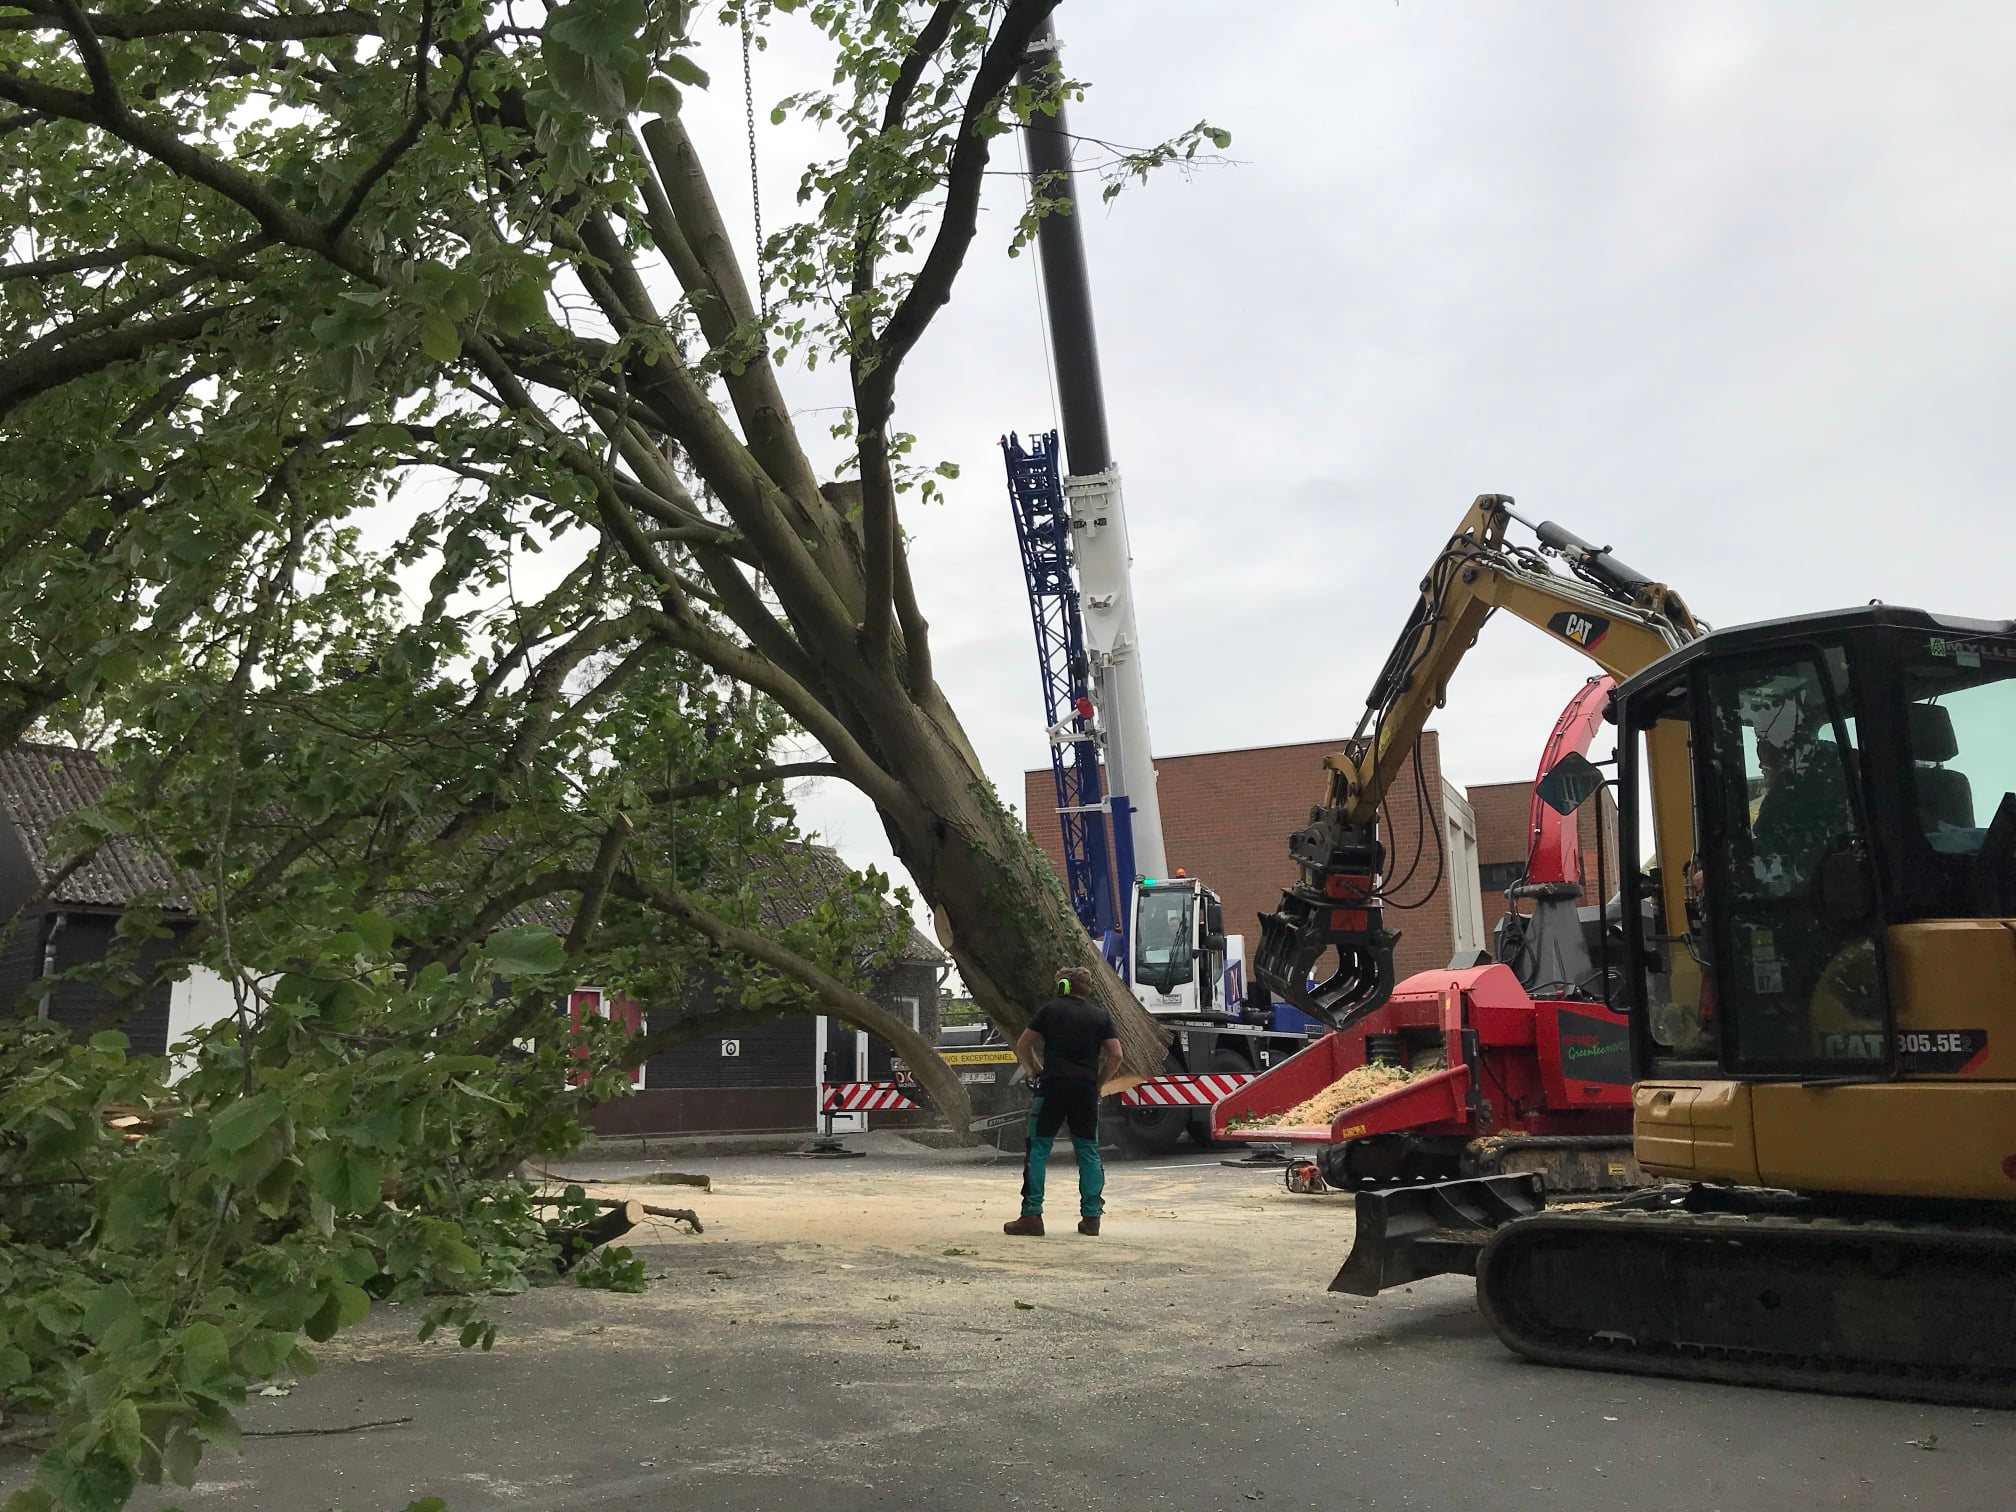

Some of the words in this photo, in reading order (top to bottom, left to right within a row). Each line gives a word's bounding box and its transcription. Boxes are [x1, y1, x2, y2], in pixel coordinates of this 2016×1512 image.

[1565, 613, 1593, 645] CAT
[961, 1053, 1014, 1062] EXCEPTIONNEL
[1825, 1034, 1885, 1058] CAT
